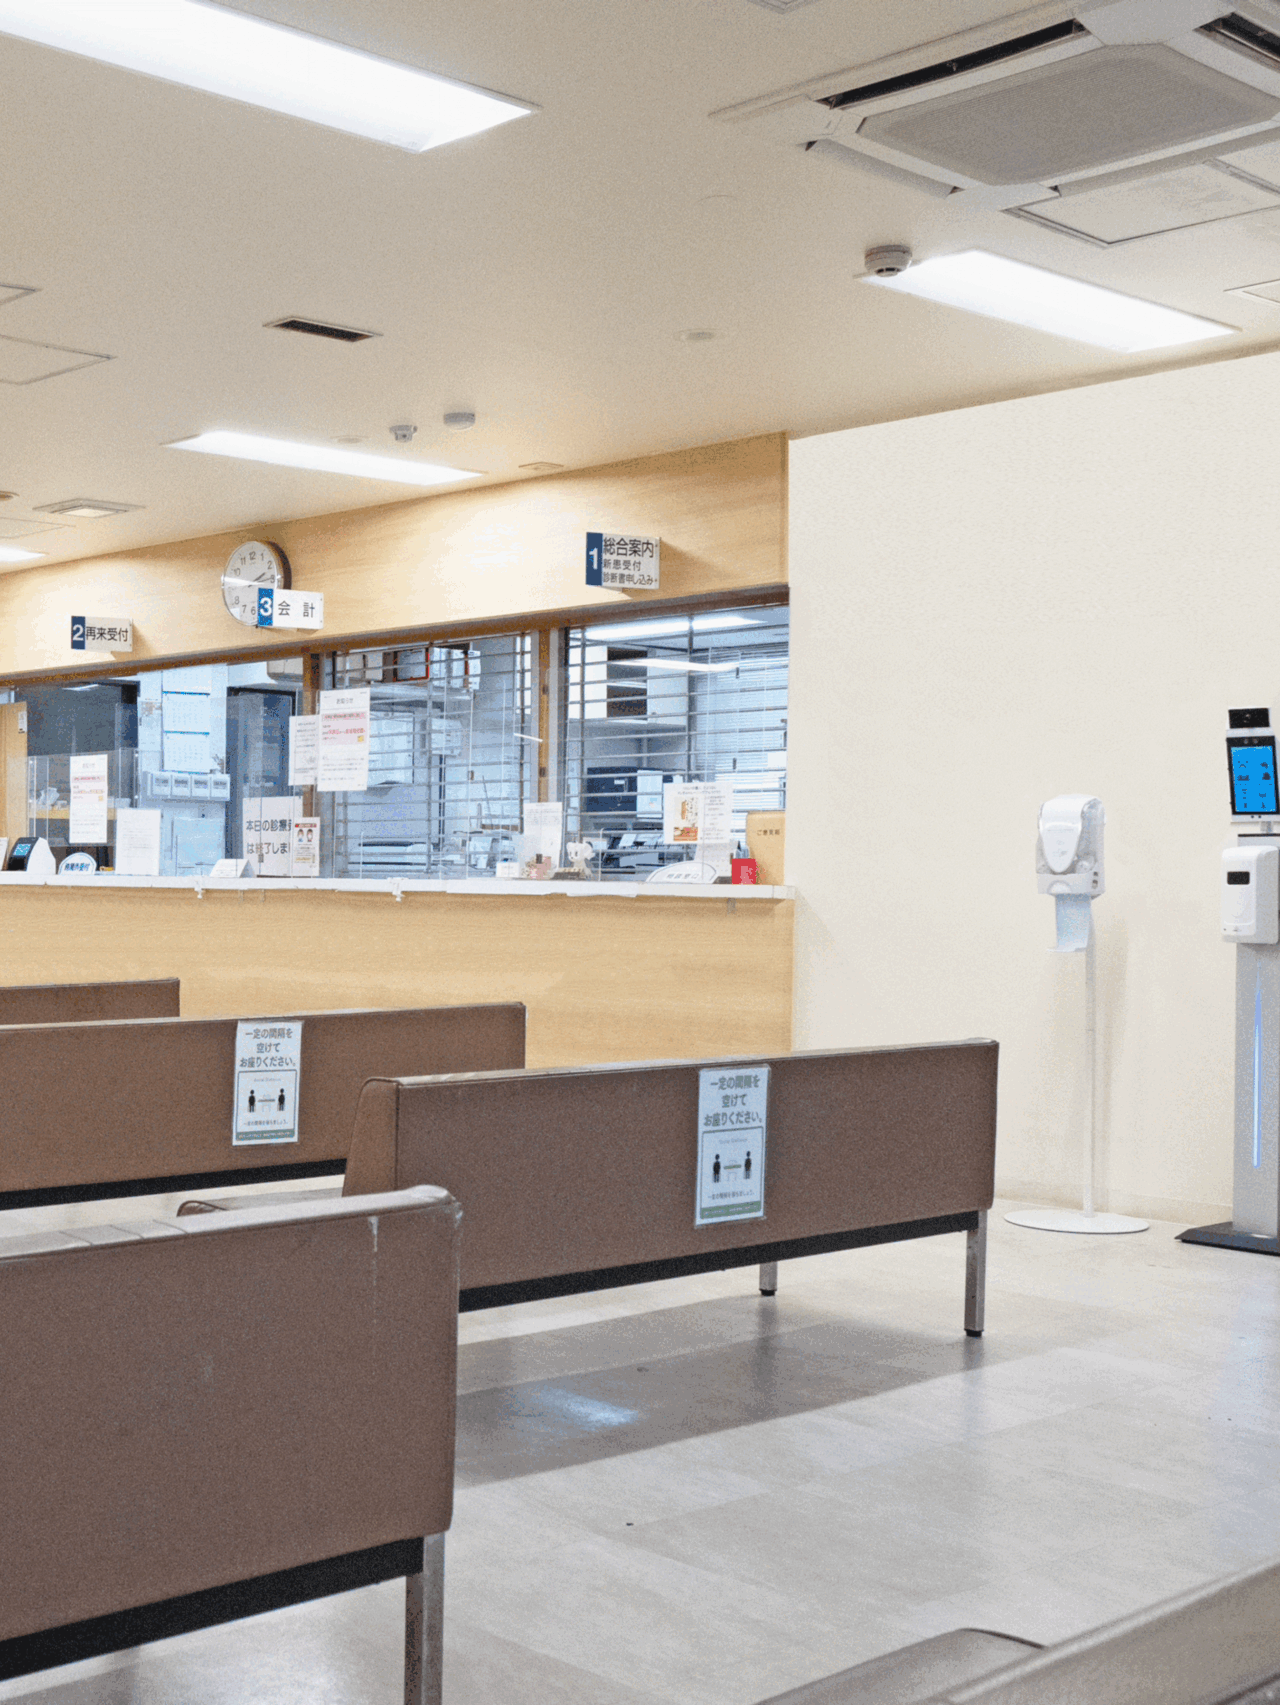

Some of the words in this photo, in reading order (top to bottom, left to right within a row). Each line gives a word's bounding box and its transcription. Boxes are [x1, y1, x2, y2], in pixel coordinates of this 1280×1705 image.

[603, 537, 654, 558] 総合案内
[241, 557, 246, 565] 11
[249, 551, 256, 560] 12
[589, 547, 598, 570] 1
[268, 561, 272, 570] 2
[603, 558, 641, 571] 新患受付
[235, 596, 240, 605] 8
[260, 597, 272, 616] 3
[242, 605, 247, 613] 7
[251, 606, 256, 615] 6
[73, 624, 84, 641] 2
[86, 626, 129, 642] 再来受付
[245, 1027, 293, 1040] 一定の間隔を
[256, 1042, 281, 1054] 空けて
[239, 1055, 296, 1068] お座りください。
[710, 1074, 761, 1091] 一定の間隔を
[721, 1093, 748, 1109] 空けて
[703, 1110, 763, 1127] お座りください。
